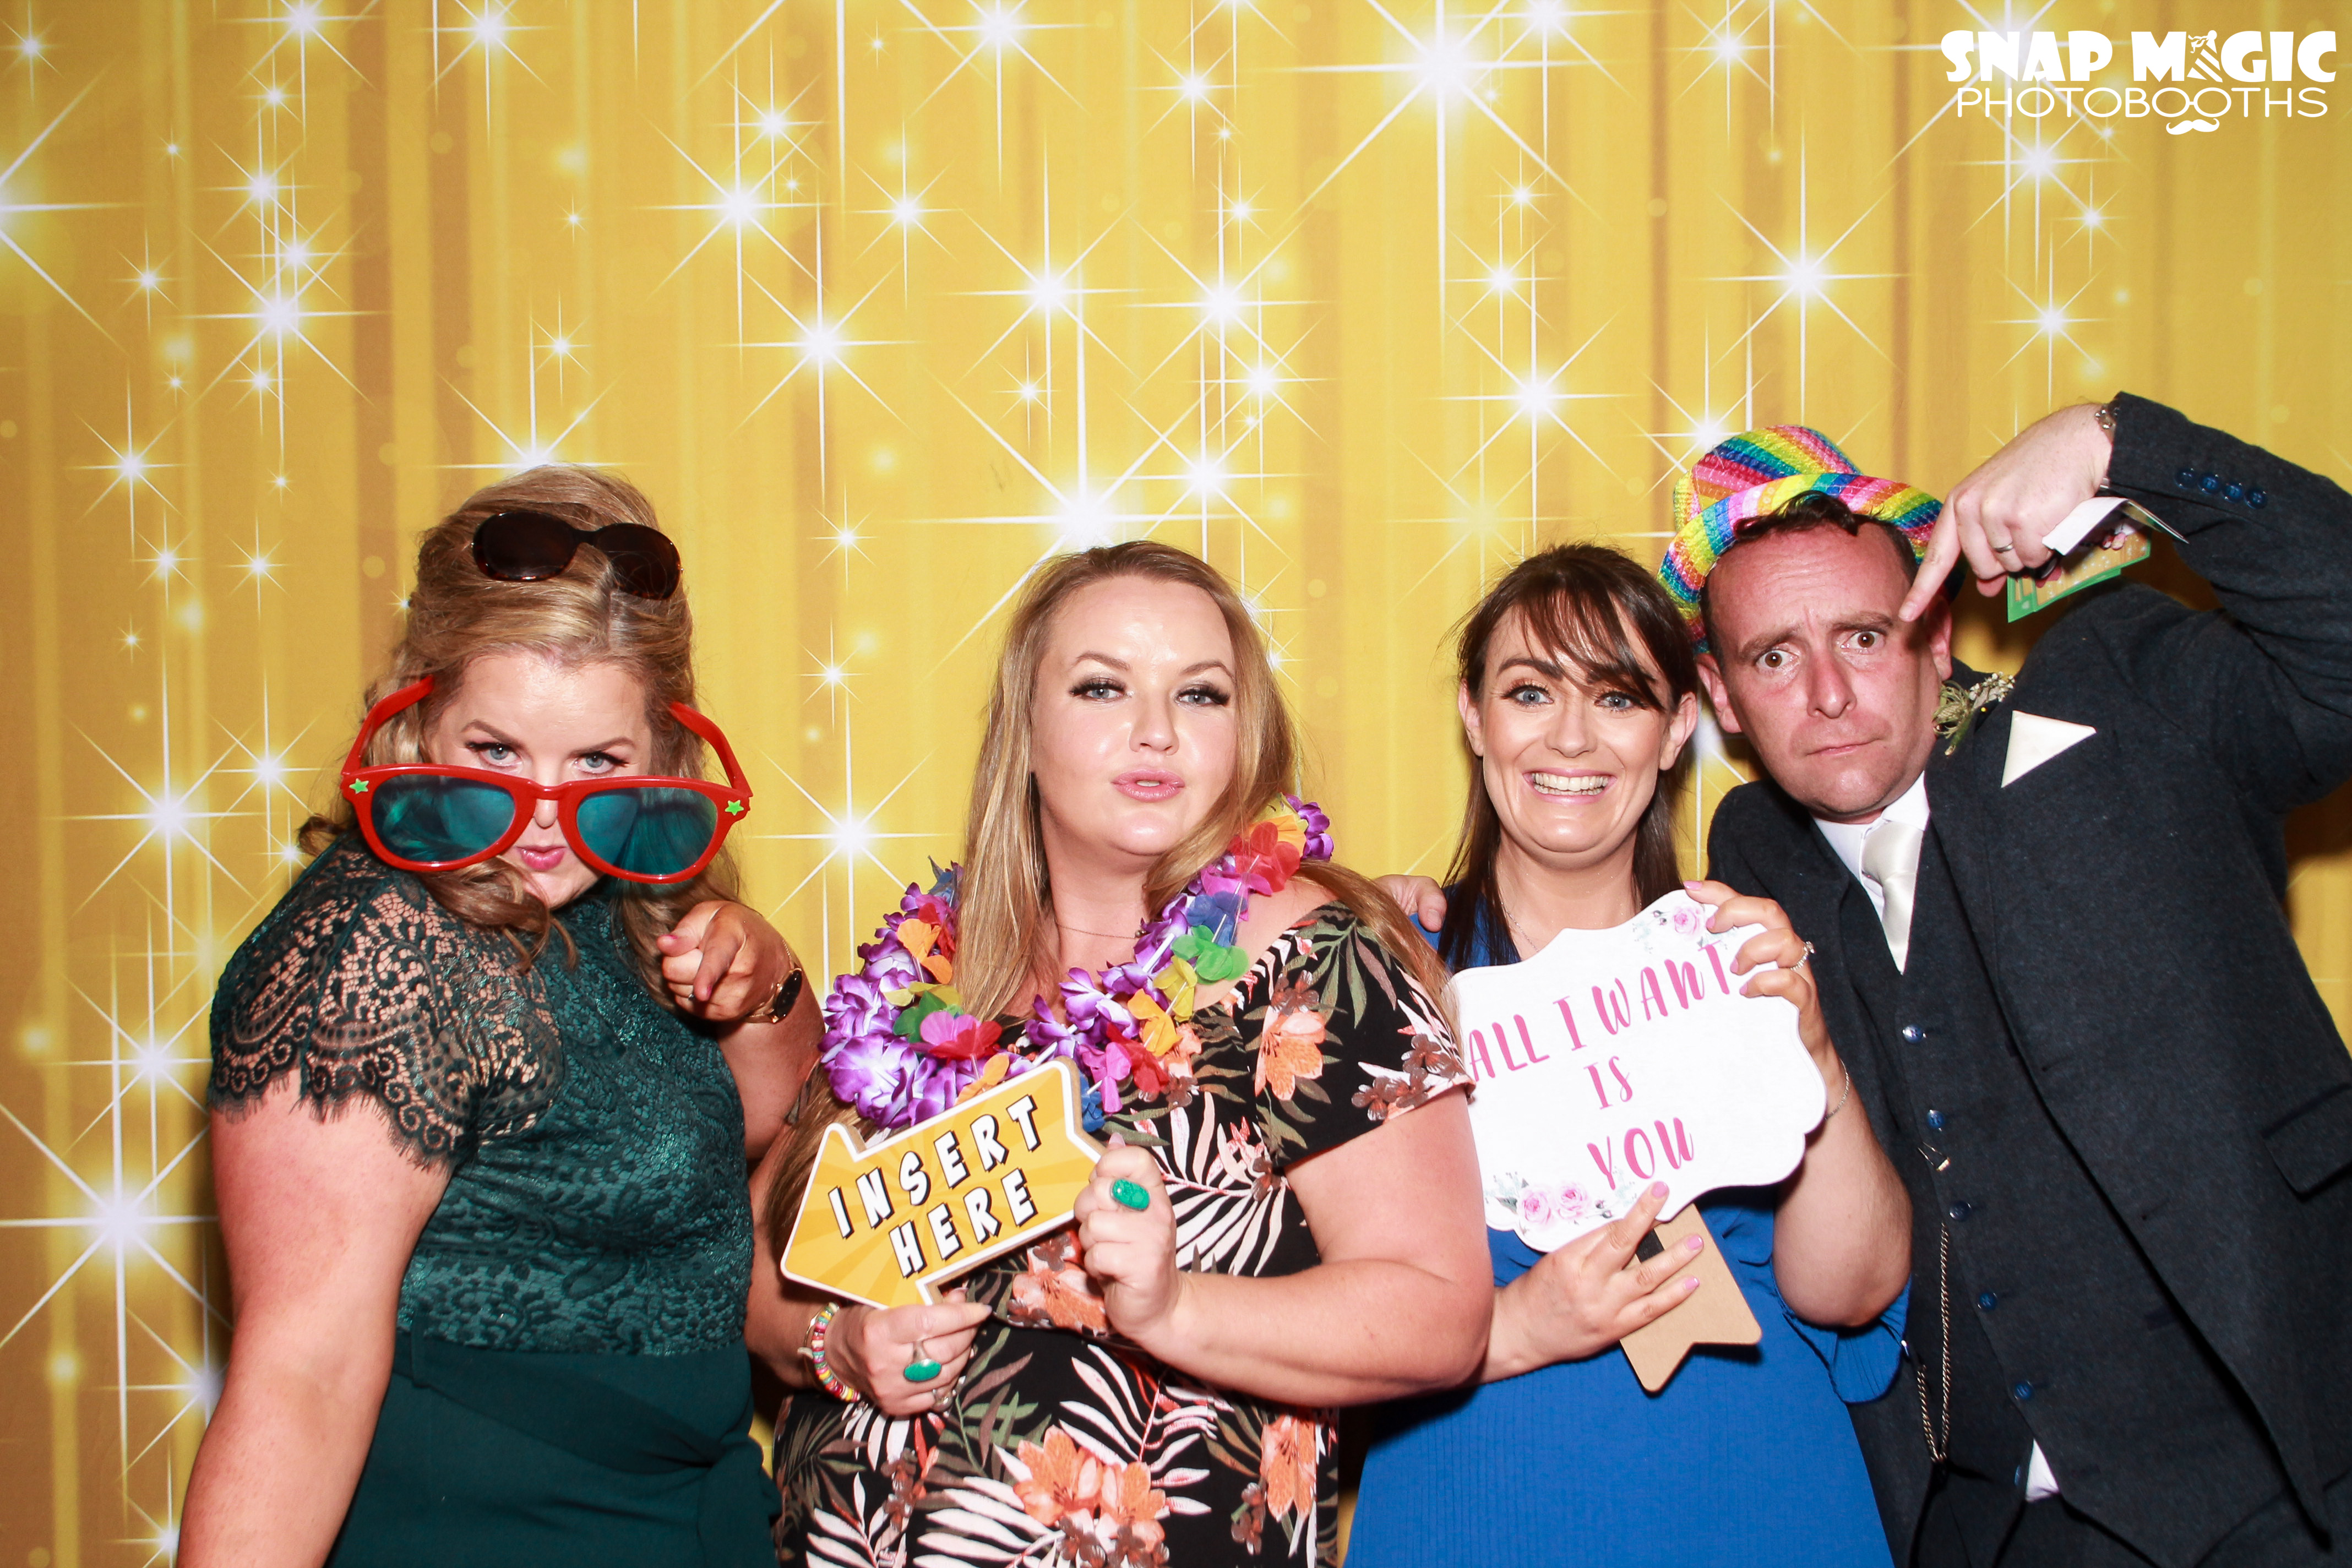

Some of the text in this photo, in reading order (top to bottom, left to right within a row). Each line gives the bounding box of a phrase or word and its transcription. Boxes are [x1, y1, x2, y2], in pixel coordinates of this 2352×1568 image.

[1469, 940, 1730, 1082] ALL I WANT
[1583, 1055, 1633, 1109] IS
[828, 1094, 1042, 1238] INSERT
[1587, 1117, 1694, 1190] YOU
[888, 1168, 1038, 1278] HERE
